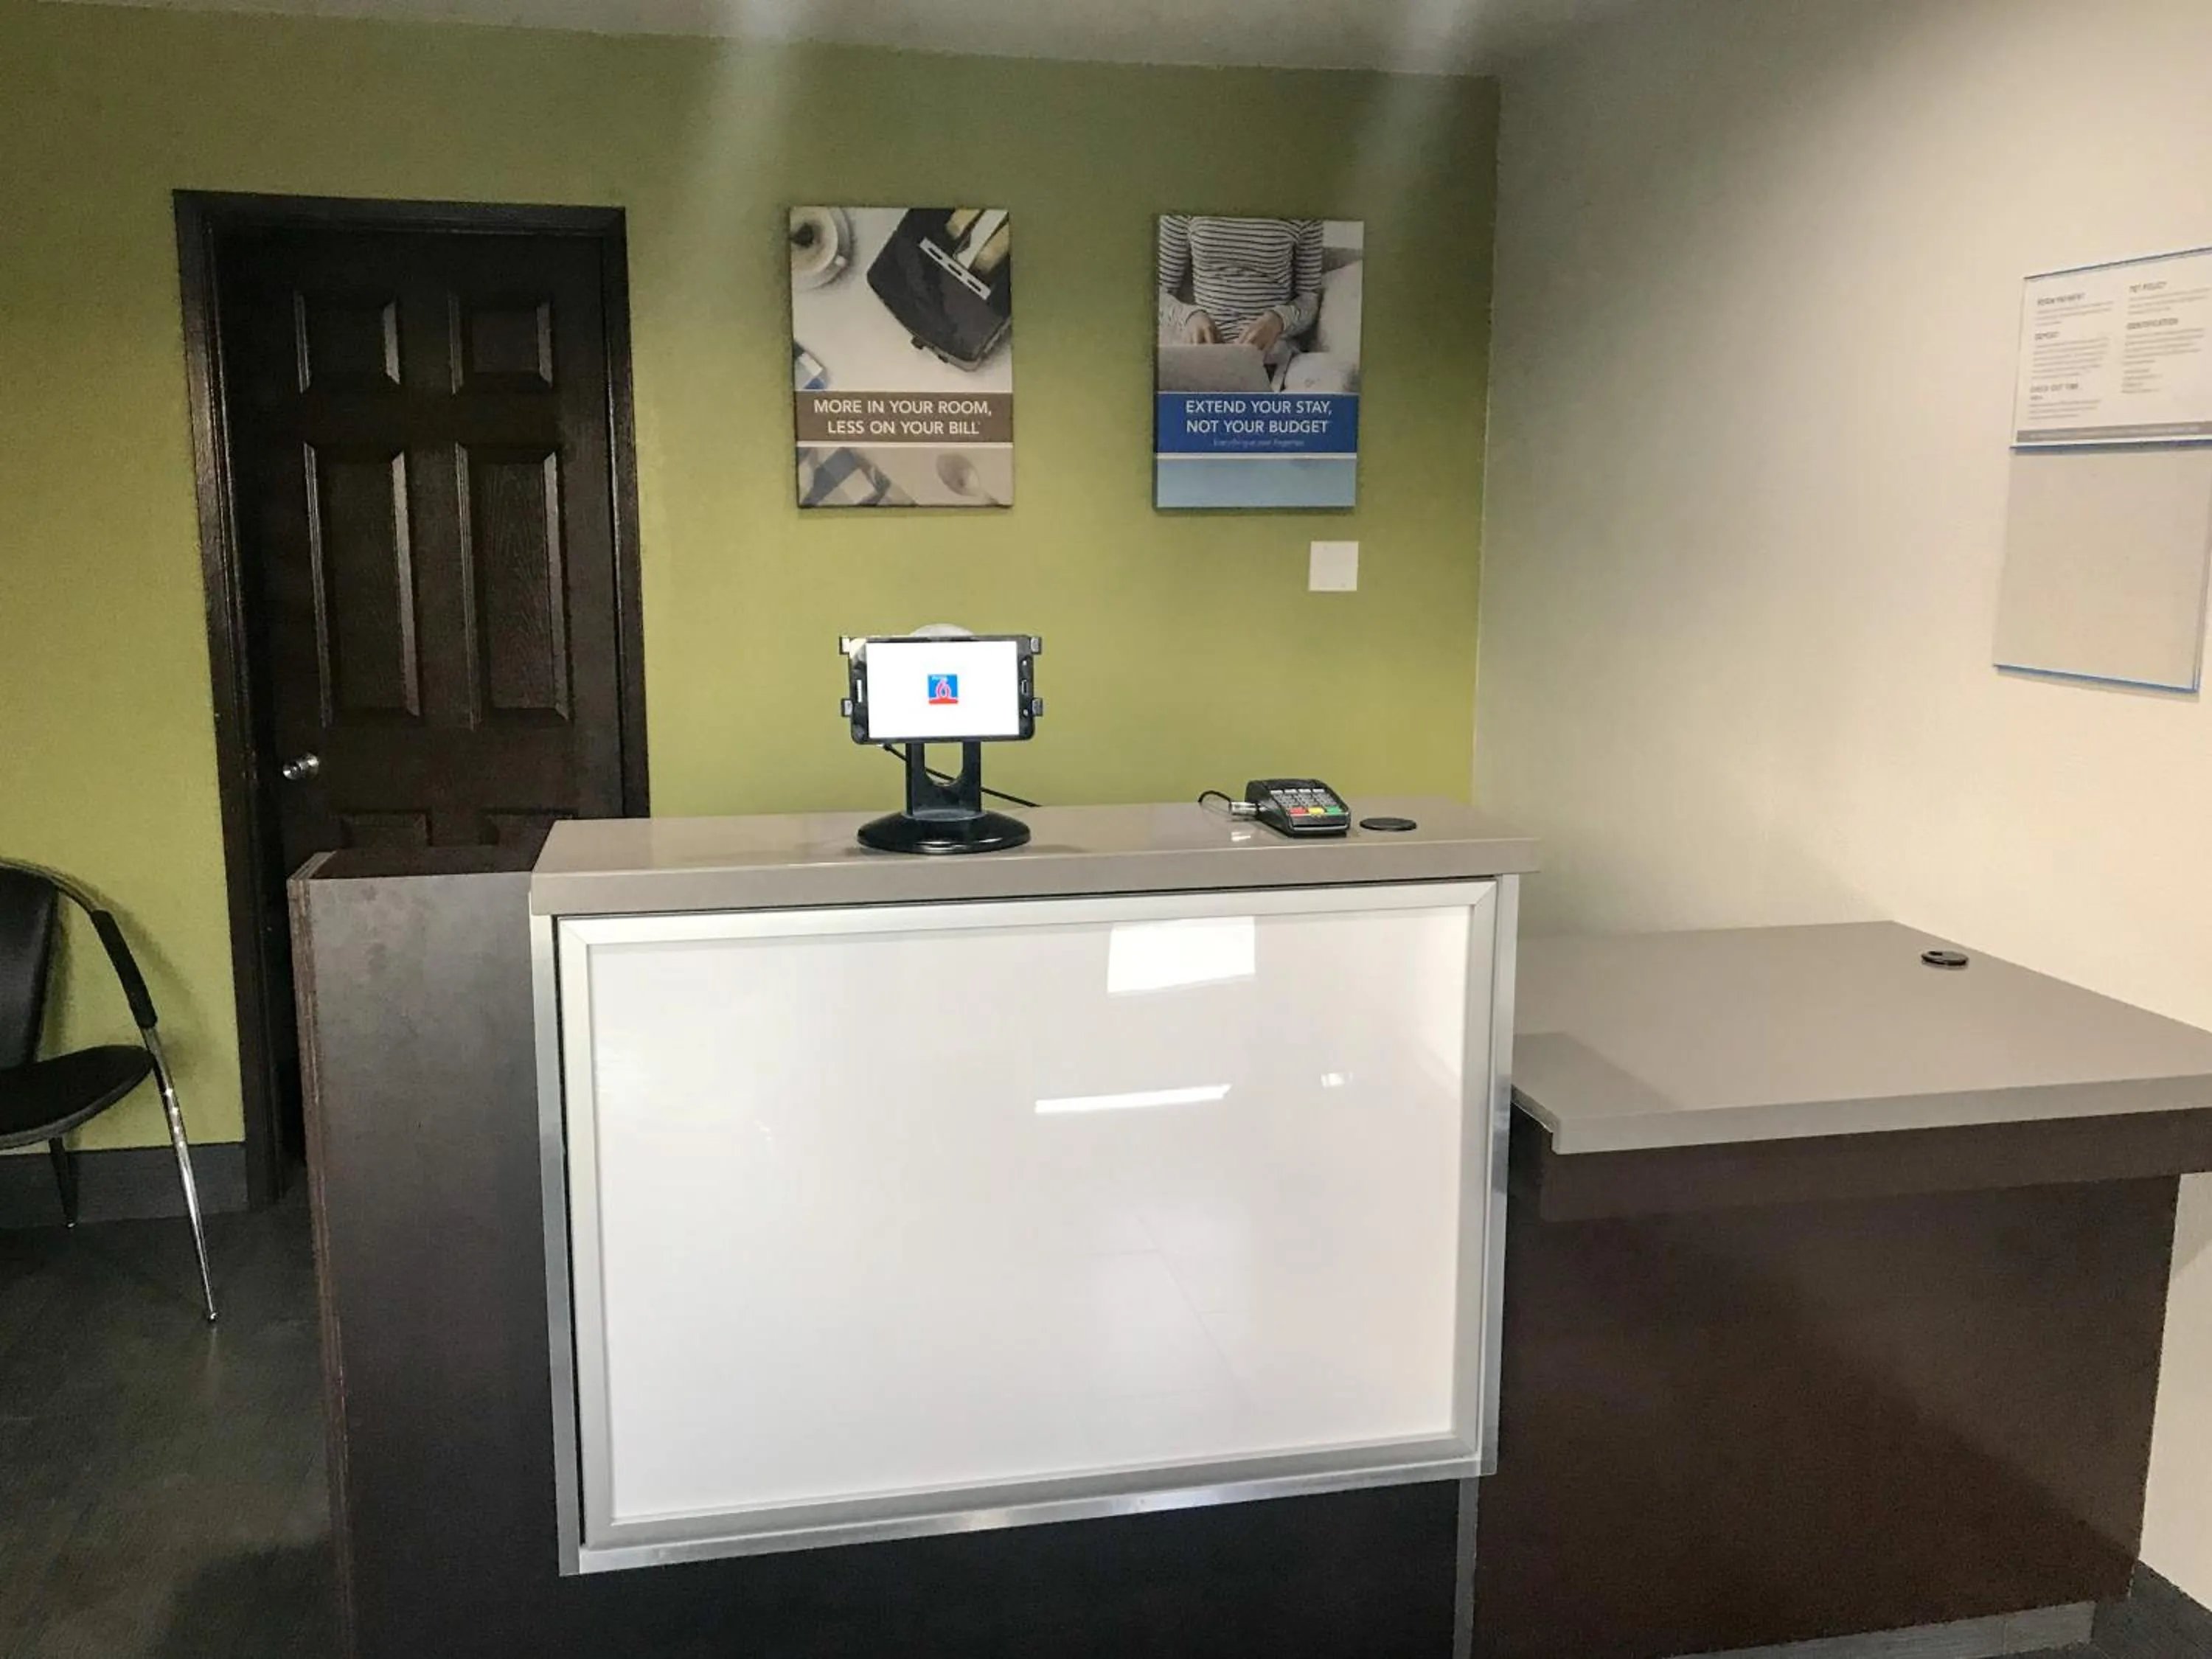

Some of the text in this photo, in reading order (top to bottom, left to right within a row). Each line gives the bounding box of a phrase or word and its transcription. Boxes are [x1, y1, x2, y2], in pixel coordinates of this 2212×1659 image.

[813, 400, 992, 417] MORE IN YOUR ROOM,
[1186, 400, 1332, 416] EXTEND YOUR STAY,
[827, 420, 979, 434] LESS ON YOUR BILL
[1186, 420, 1328, 433] NOT YOUR BUDGET
